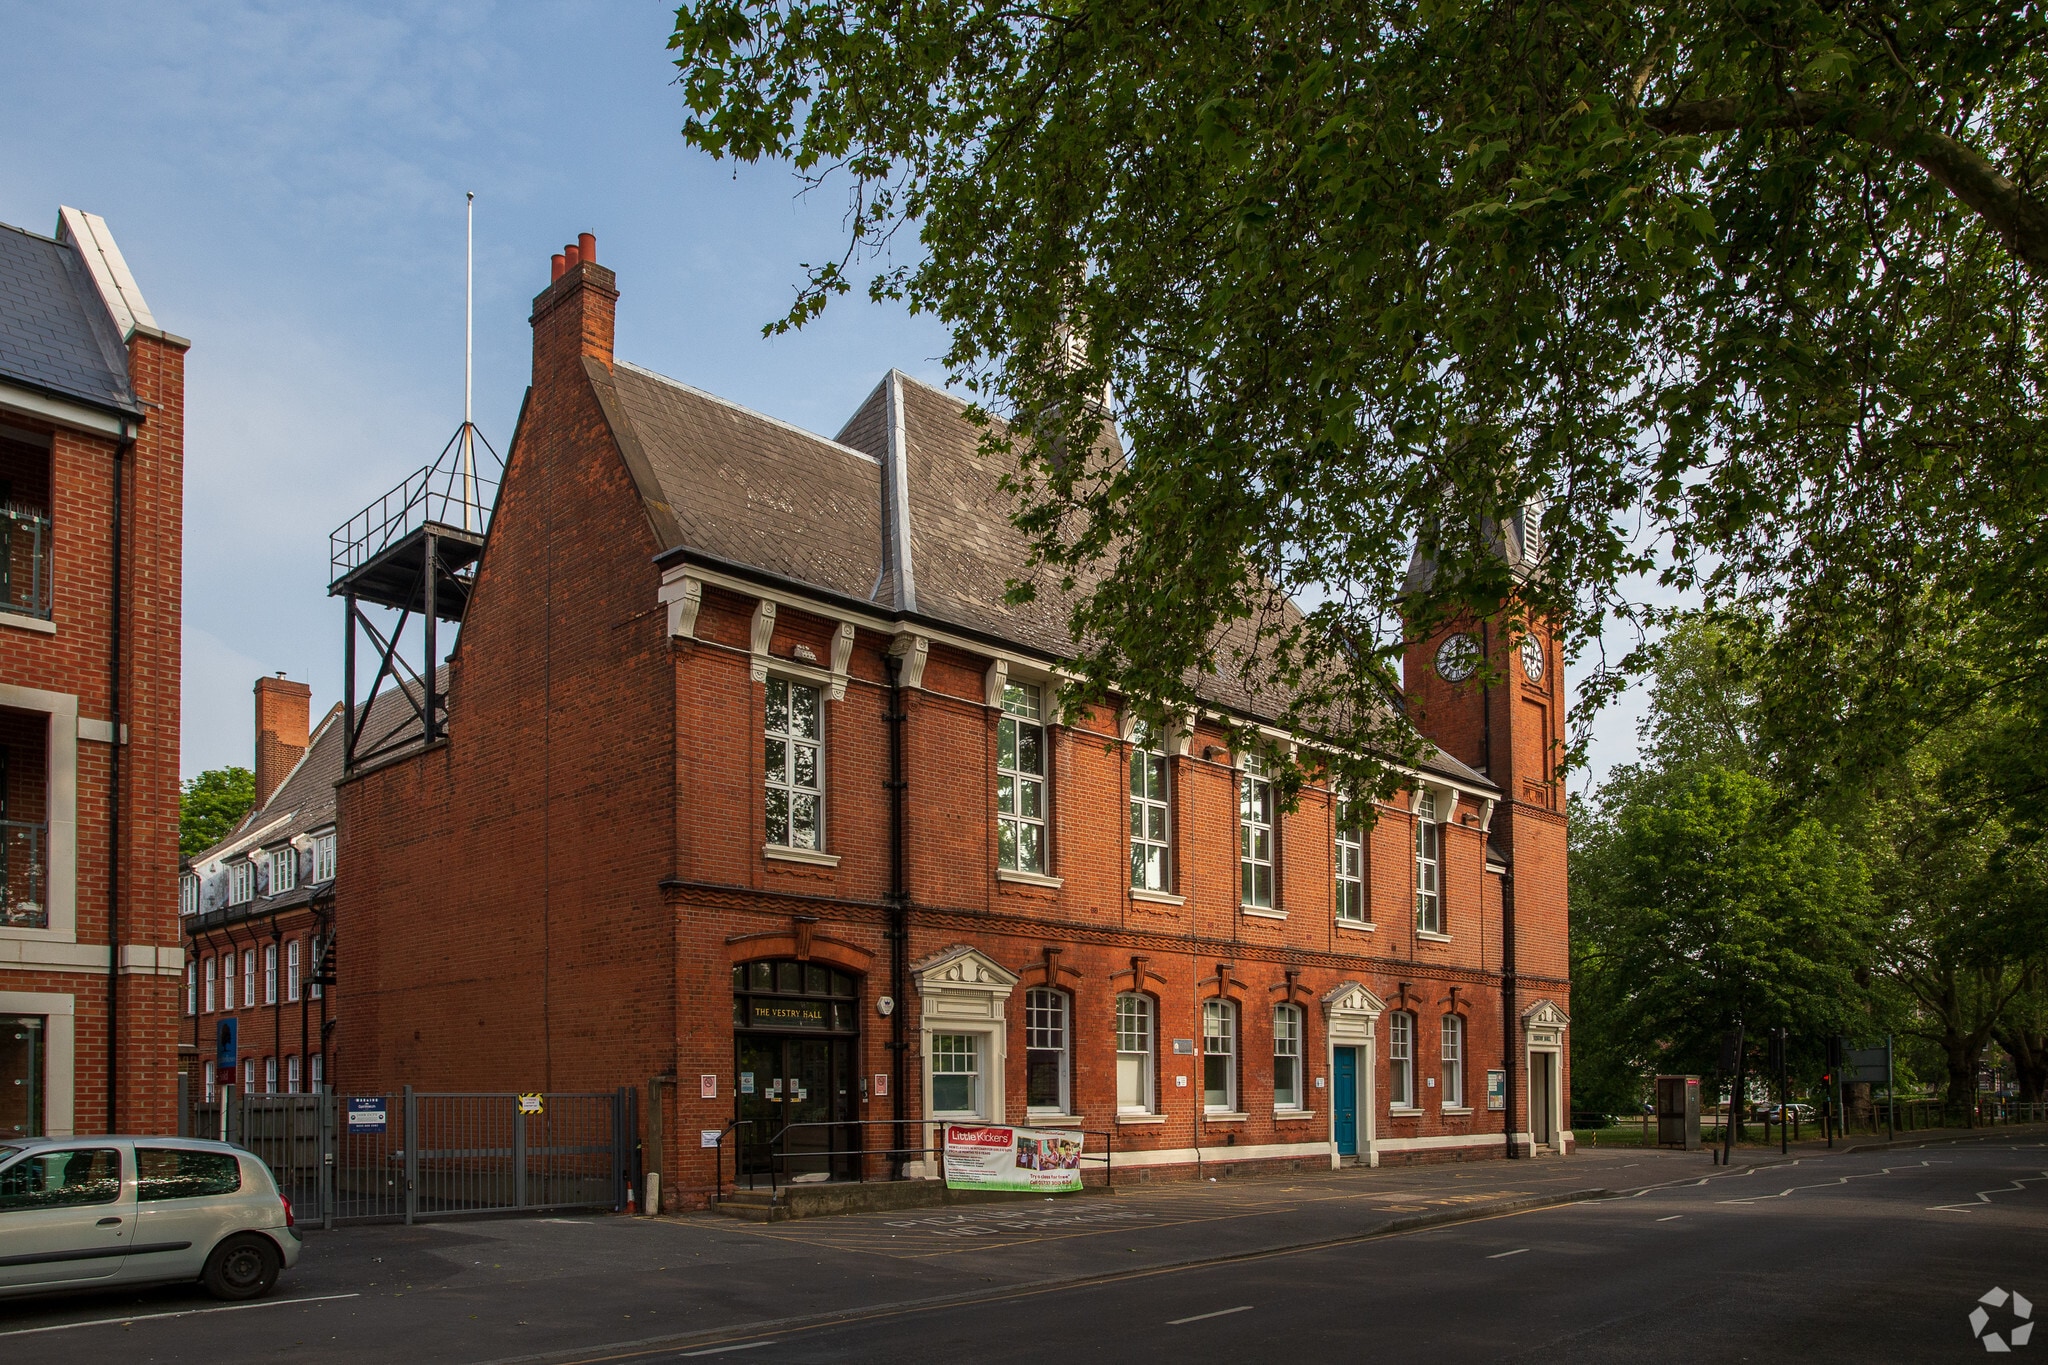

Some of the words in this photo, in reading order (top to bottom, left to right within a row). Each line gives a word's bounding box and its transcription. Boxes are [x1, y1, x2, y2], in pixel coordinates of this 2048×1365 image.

[755, 1007, 770, 1017] THE
[772, 1009, 800, 1018] VESTRY
[803, 1010, 822, 1019] HALL
[951, 1130, 976, 1140] Little
[976, 1132, 1008, 1143] Kickers
